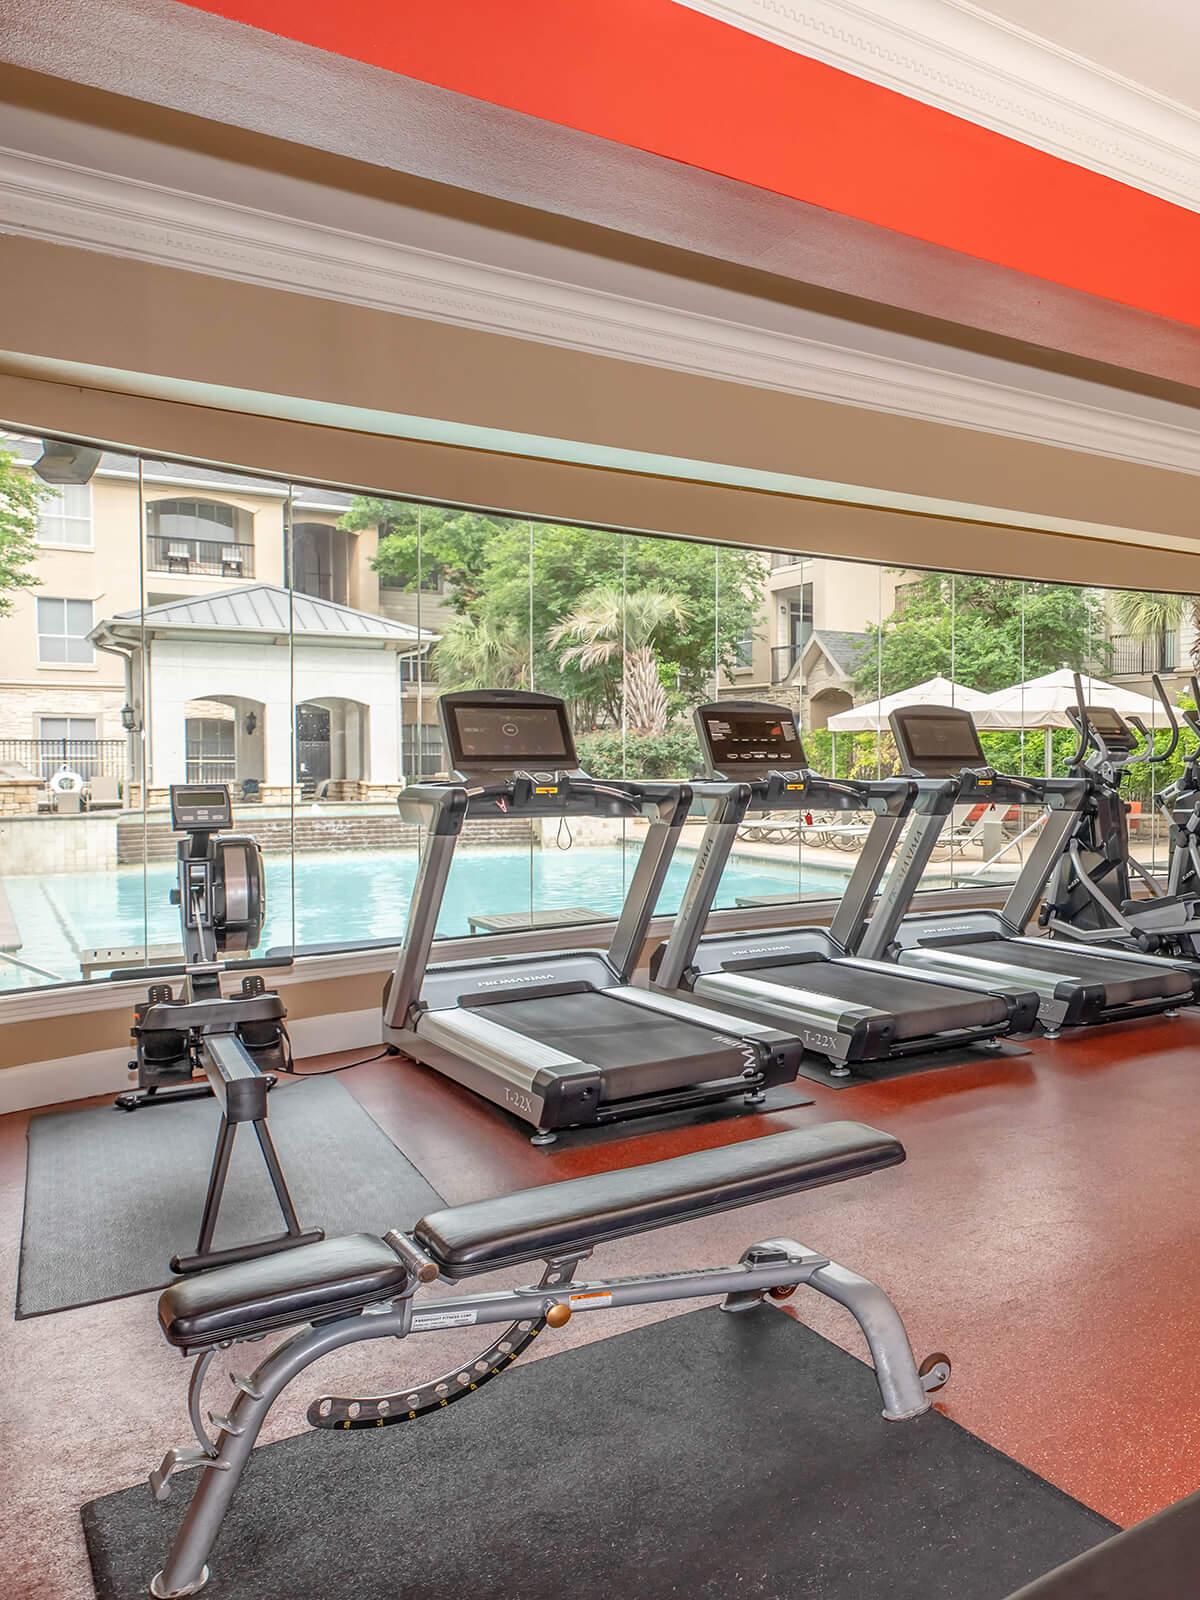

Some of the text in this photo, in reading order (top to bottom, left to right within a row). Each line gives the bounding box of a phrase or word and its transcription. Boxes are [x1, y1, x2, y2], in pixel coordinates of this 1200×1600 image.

[477, 974, 556, 987] PROMAXIMA
[804, 1030, 837, 1049] T-22X
[503, 1087, 532, 1112] T-22X
